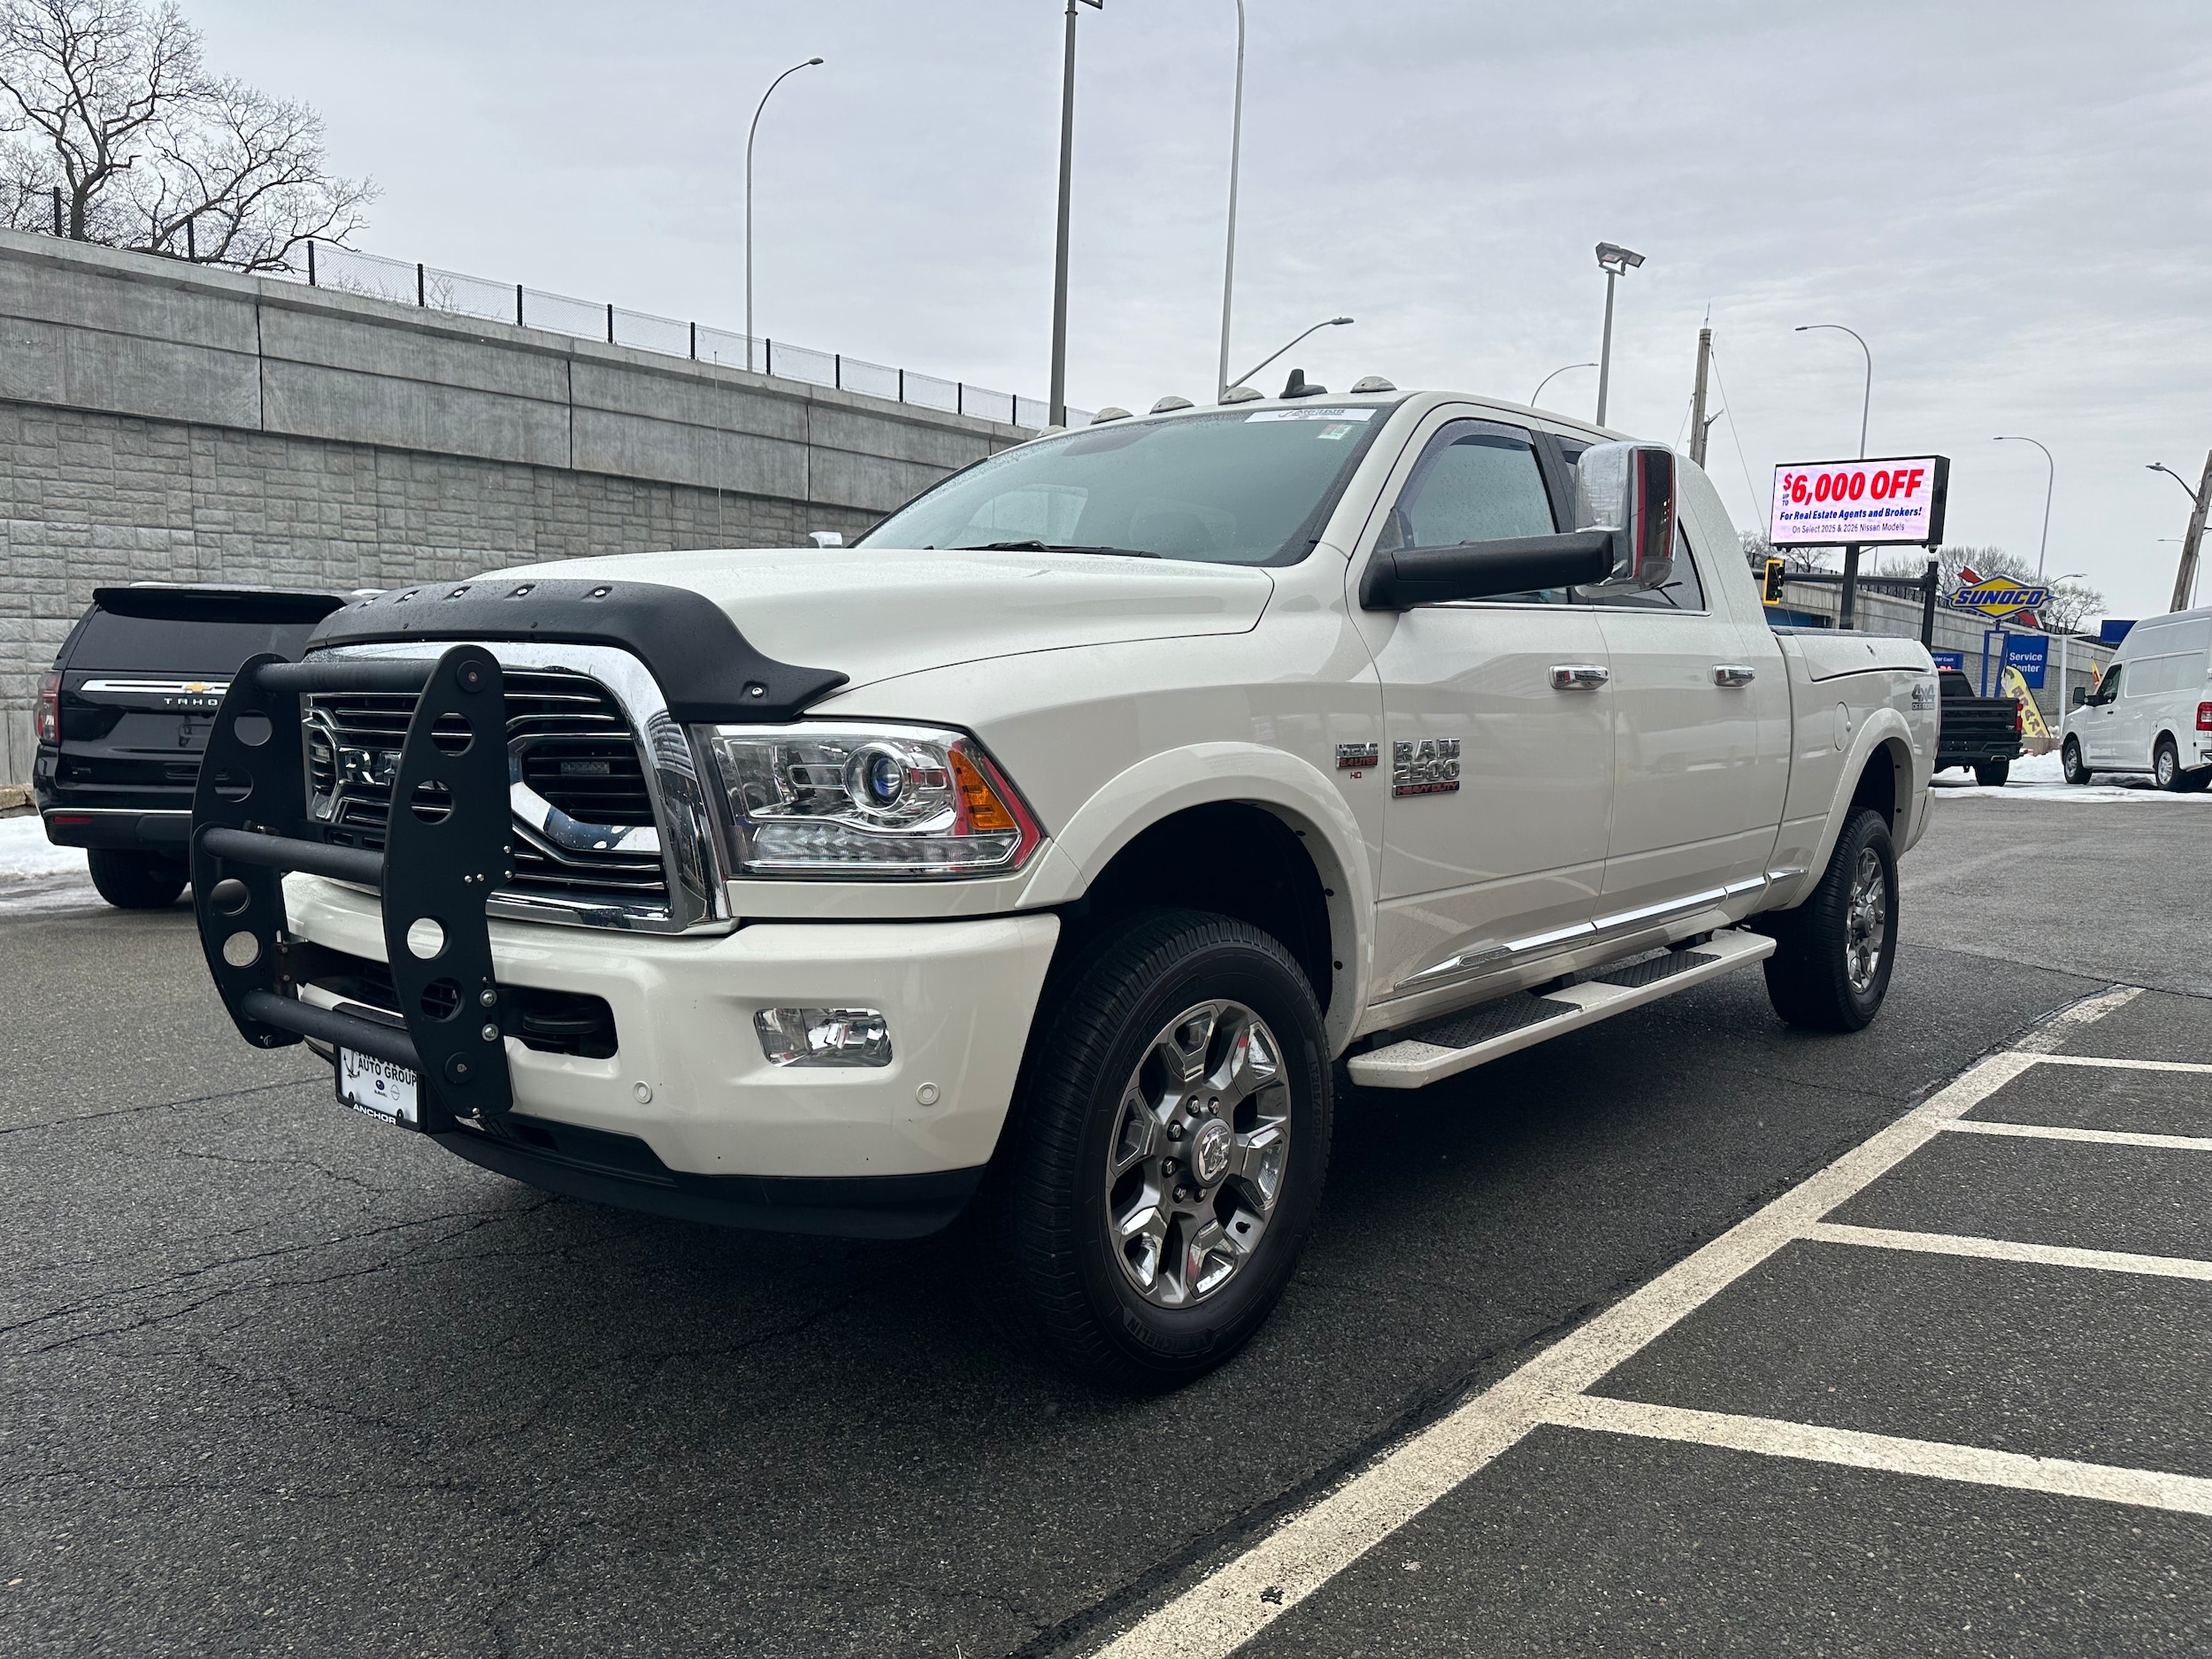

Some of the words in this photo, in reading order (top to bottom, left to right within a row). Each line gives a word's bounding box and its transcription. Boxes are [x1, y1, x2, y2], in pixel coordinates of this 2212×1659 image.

[1783, 472, 1865, 505] $6,000
[1870, 469, 1924, 500] OFF
[1780, 511, 1793, 520] For
[1793, 511, 1812, 520] Real
[1813, 510, 1838, 519] Estate
[1839, 509, 1867, 520] Agents
[1868, 508, 1883, 518] and
[1885, 507, 1923, 517] Brokers!
[1801, 525, 1820, 534] Select
[1821, 524, 1836, 533] 2025
[1837, 524, 1842, 533] &
[1843, 524, 1858, 533] 2026
[1860, 523, 1881, 532] Nissan
[1882, 522, 1905, 532] Models
[1955, 590, 2045, 605] SUNOCO
[2009, 652, 2043, 662] Service
[164, 697, 219, 706] TAHO
[1393, 738, 1461, 761] RAM
[1392, 759, 1461, 784] 2500
[1397, 784, 1432, 795] HEAVY
[1432, 782, 1458, 793] DUTY
[358, 1057, 381, 1076] AUTO
[384, 1066, 417, 1087] GROUP
[353, 1103, 396, 1125] ANCHOR
